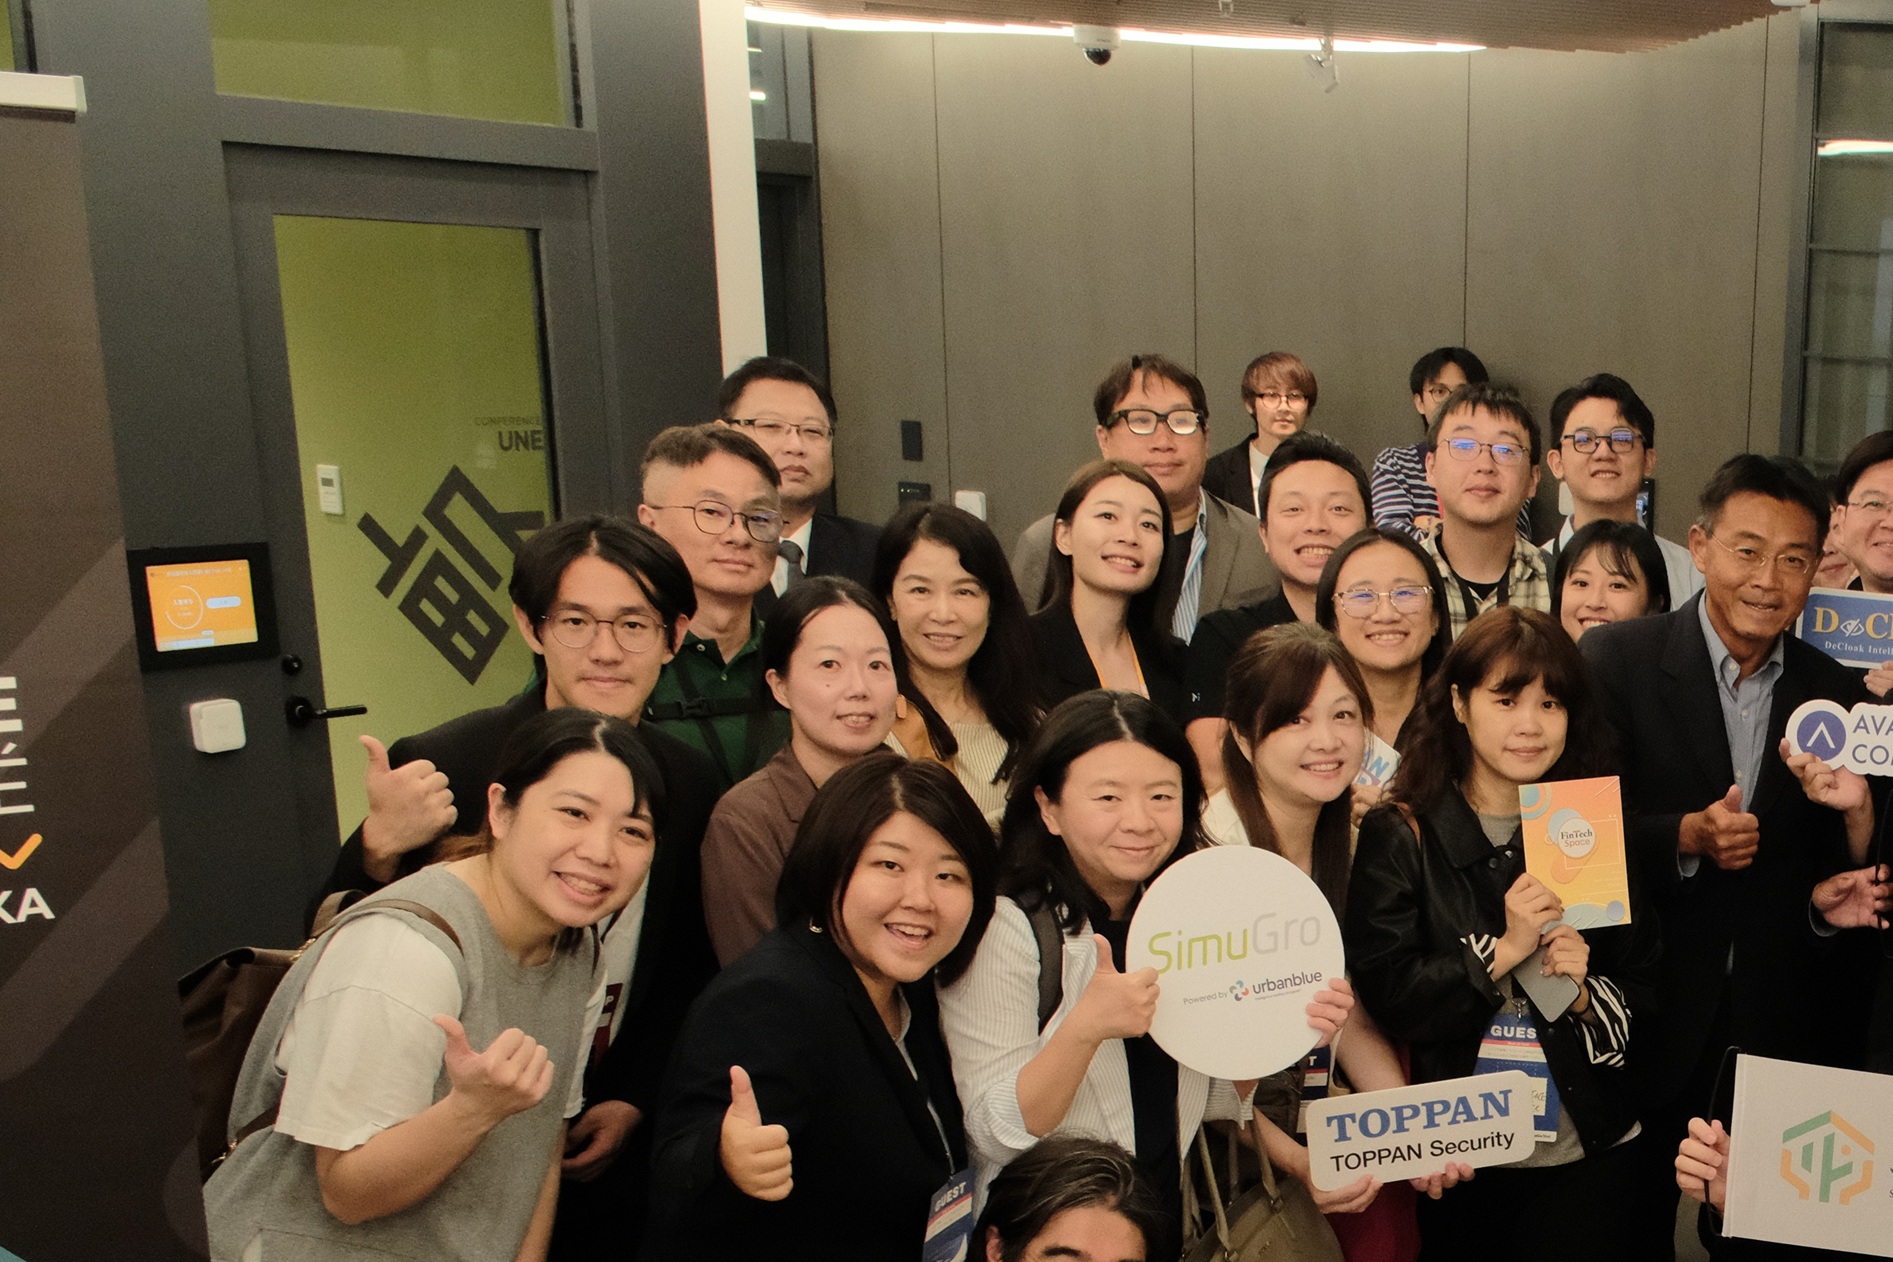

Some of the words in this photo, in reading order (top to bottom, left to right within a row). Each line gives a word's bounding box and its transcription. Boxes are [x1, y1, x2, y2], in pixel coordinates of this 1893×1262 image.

[497, 430, 544, 452] UNE
[1824, 640, 1865, 653] DeCloak
[1560, 828, 1593, 840] FinTech
[1565, 839, 1591, 848] Space
[1148, 912, 1321, 975] SimuGro
[1183, 993, 1217, 1006] Powered
[1217, 990, 1229, 1003] by
[1252, 970, 1323, 995] urbanblue
[1490, 1025, 1537, 1039] GUES
[1326, 1088, 1513, 1144] TOPPAN
[1330, 1142, 1422, 1172] TOPPAN
[1430, 1130, 1515, 1158] Security
[934, 1181, 967, 1213] GUEST
